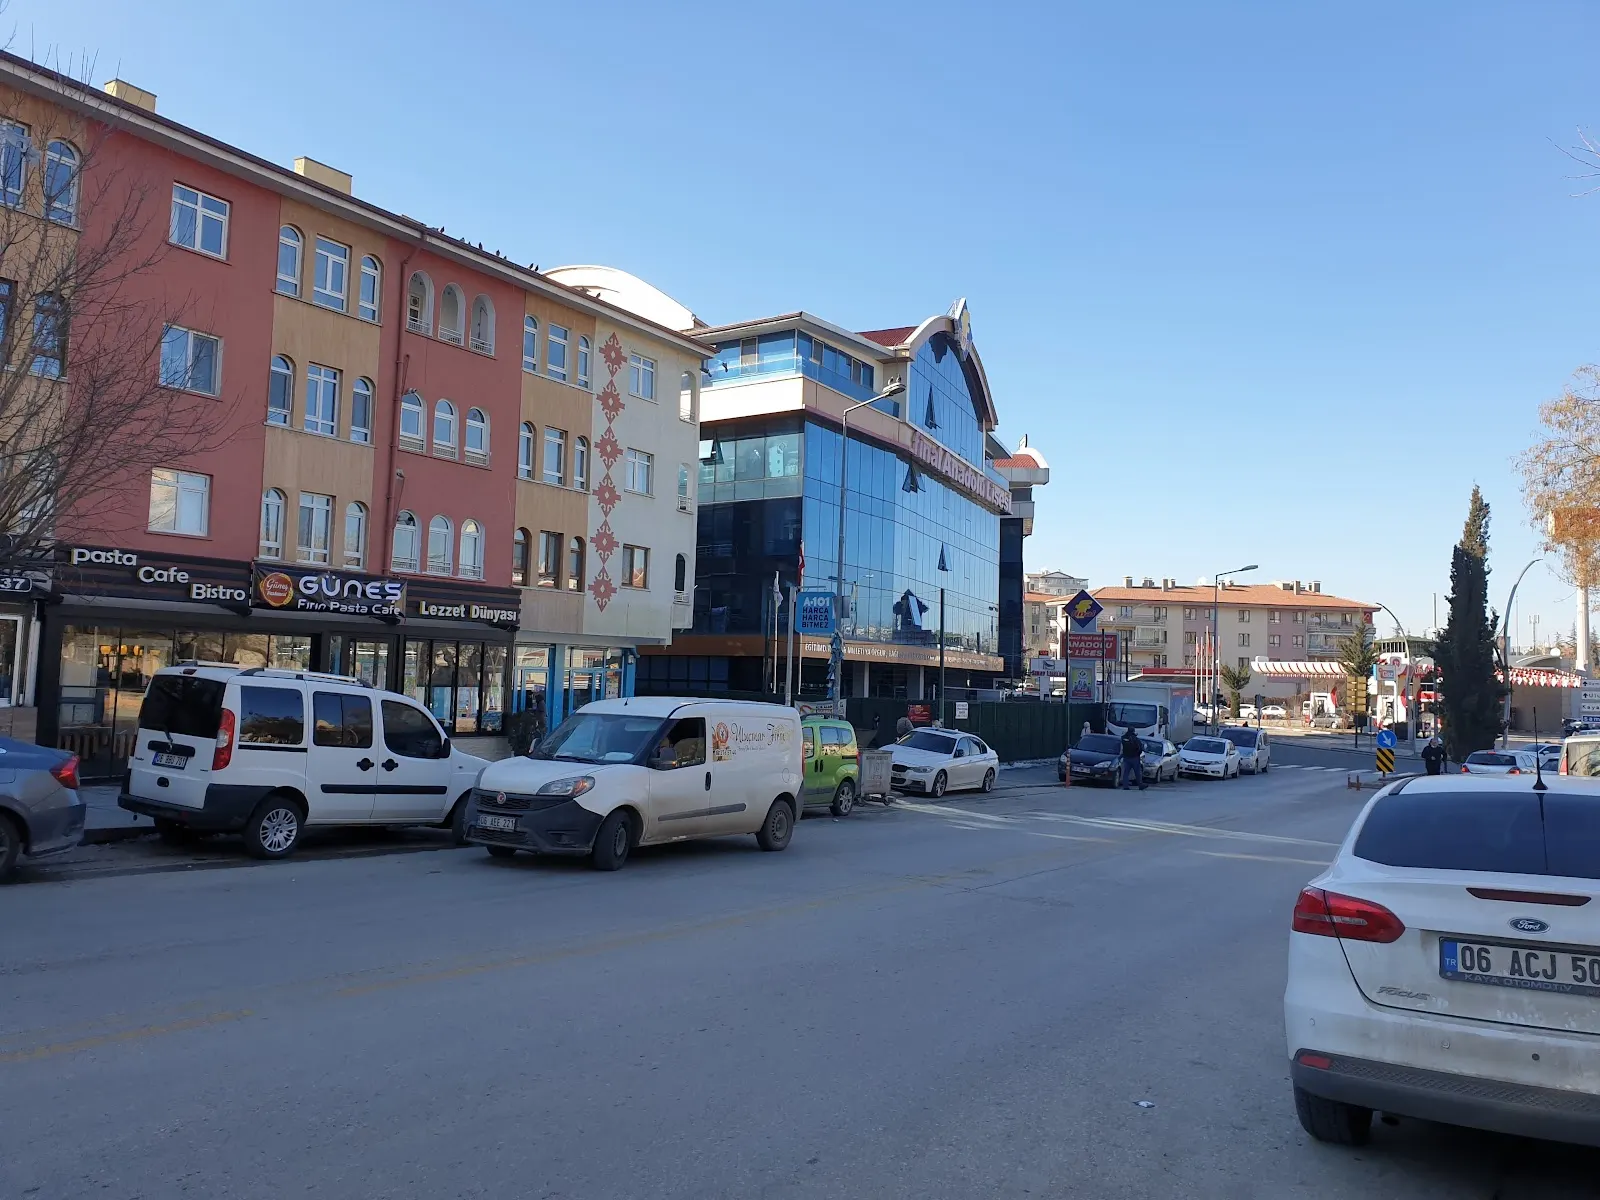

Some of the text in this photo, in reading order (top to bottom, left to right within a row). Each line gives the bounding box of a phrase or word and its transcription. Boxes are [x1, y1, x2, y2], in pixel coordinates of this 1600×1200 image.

[943, 452, 985, 497] Anadolu
[986, 480, 1012, 514] Lisesi
[138, 566, 189, 584] Cafe
[191, 583, 246, 601] Bistro
[330, 601, 367, 614] Pasta
[371, 603, 400, 615] Cafe
[420, 601, 517, 621] Lezzet Dünyası
[1518, 919, 1541, 931] Ford
[1445, 958, 1456, 967] TR
[1461, 946, 1600, 985] 06 ACJ 50
[1464, 974, 1499, 984] KAYA
